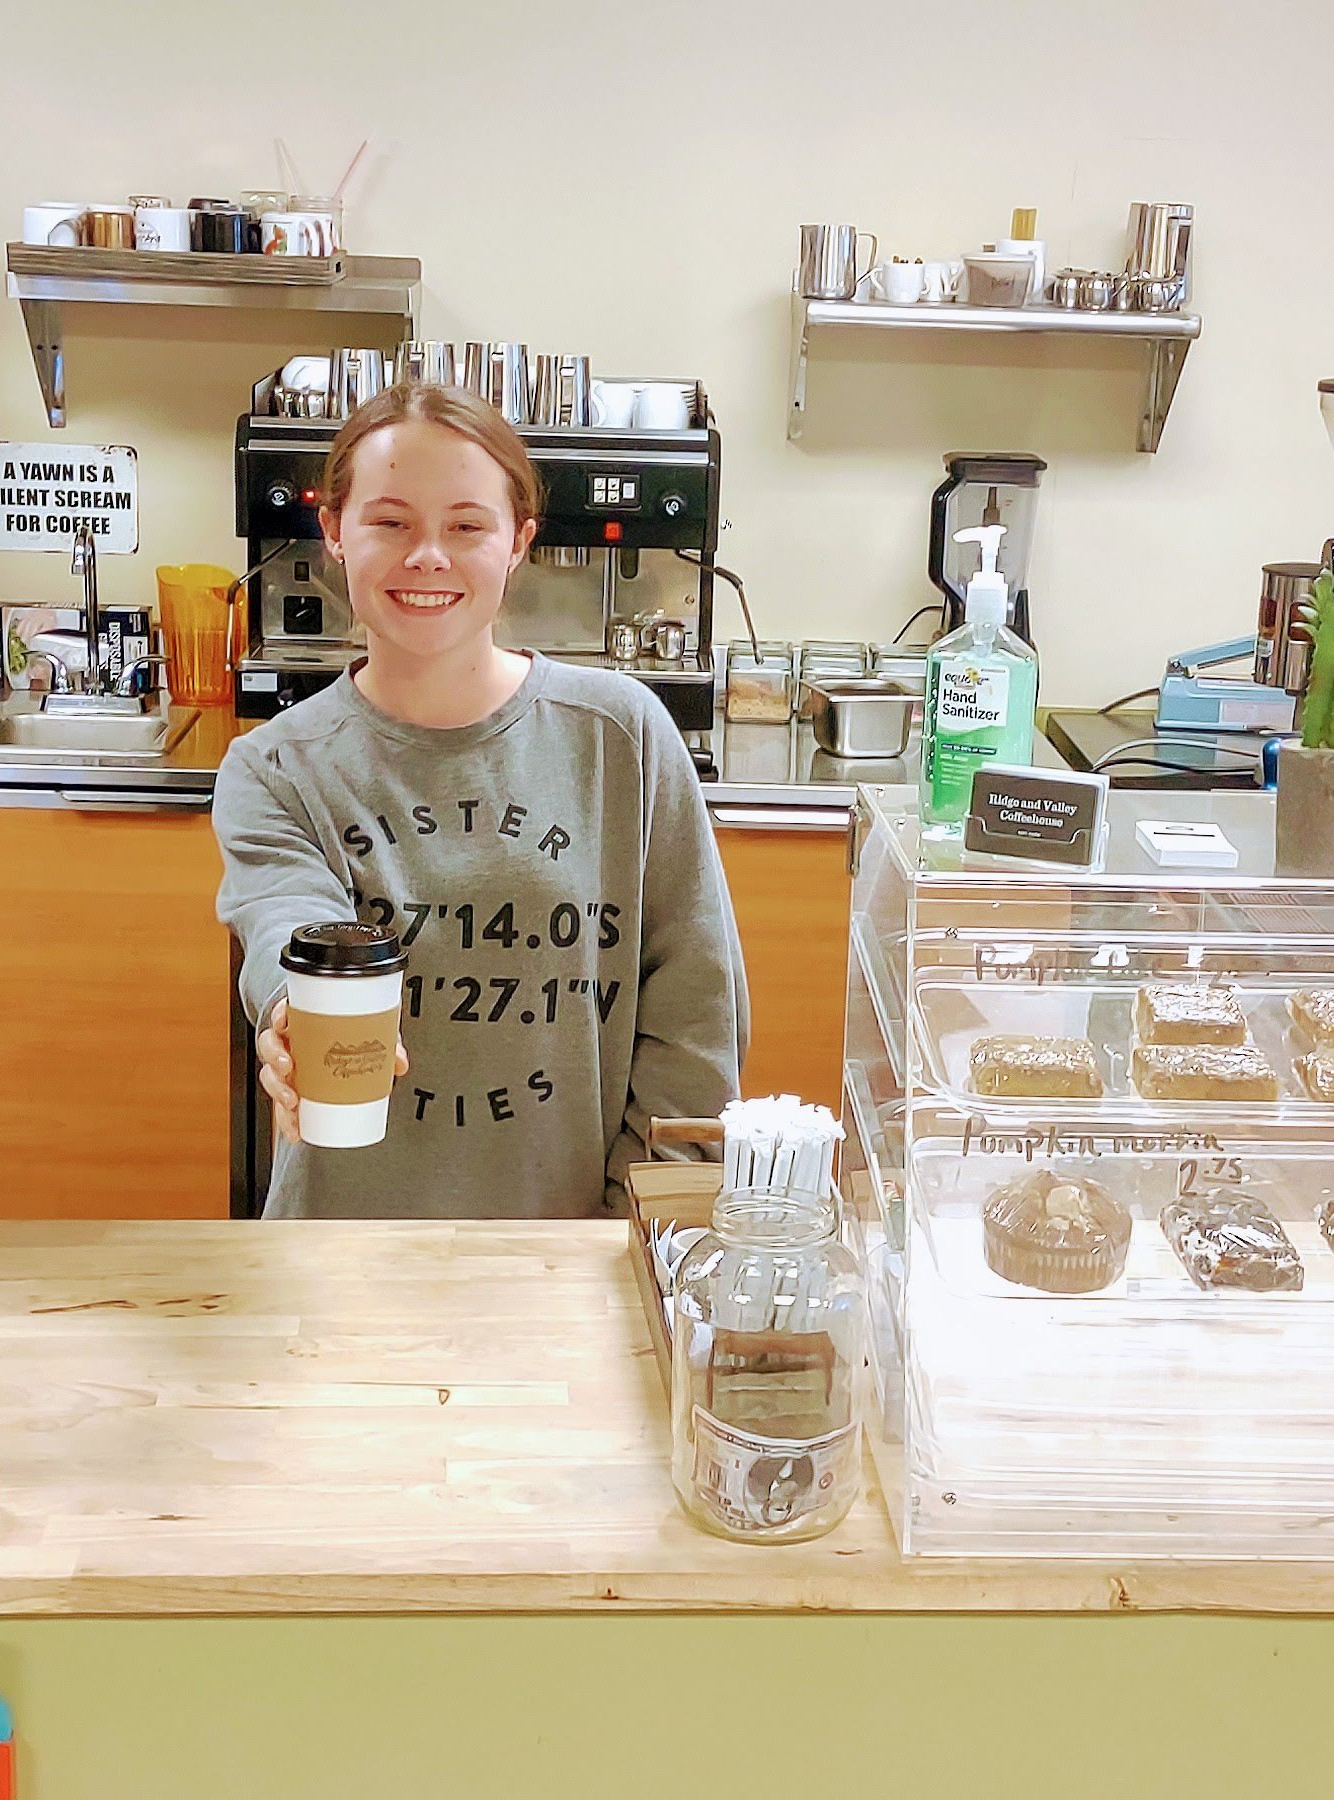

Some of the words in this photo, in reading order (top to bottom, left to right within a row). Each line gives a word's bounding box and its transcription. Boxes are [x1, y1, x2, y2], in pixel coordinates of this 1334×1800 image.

[3, 461, 17, 480] A
[19, 462, 74, 482] YAWN
[79, 464, 98, 483] IS
[102, 465, 115, 484] A
[54, 489, 132, 510] SCREAM
[6, 513, 41, 533] FOR
[46, 515, 111, 536] COFFEE
[943, 688, 978, 704] Hand
[942, 703, 1001, 722] Sanitizer
[1021, 799, 1042, 811] and
[1042, 799, 1078, 817] Valley
[342, 799, 572, 862] SISTER
[413, 1070, 555, 1128] TIES
[962, 1111, 1102, 1162] Pumpkin
[1179, 1158, 1244, 1197] 2.75
